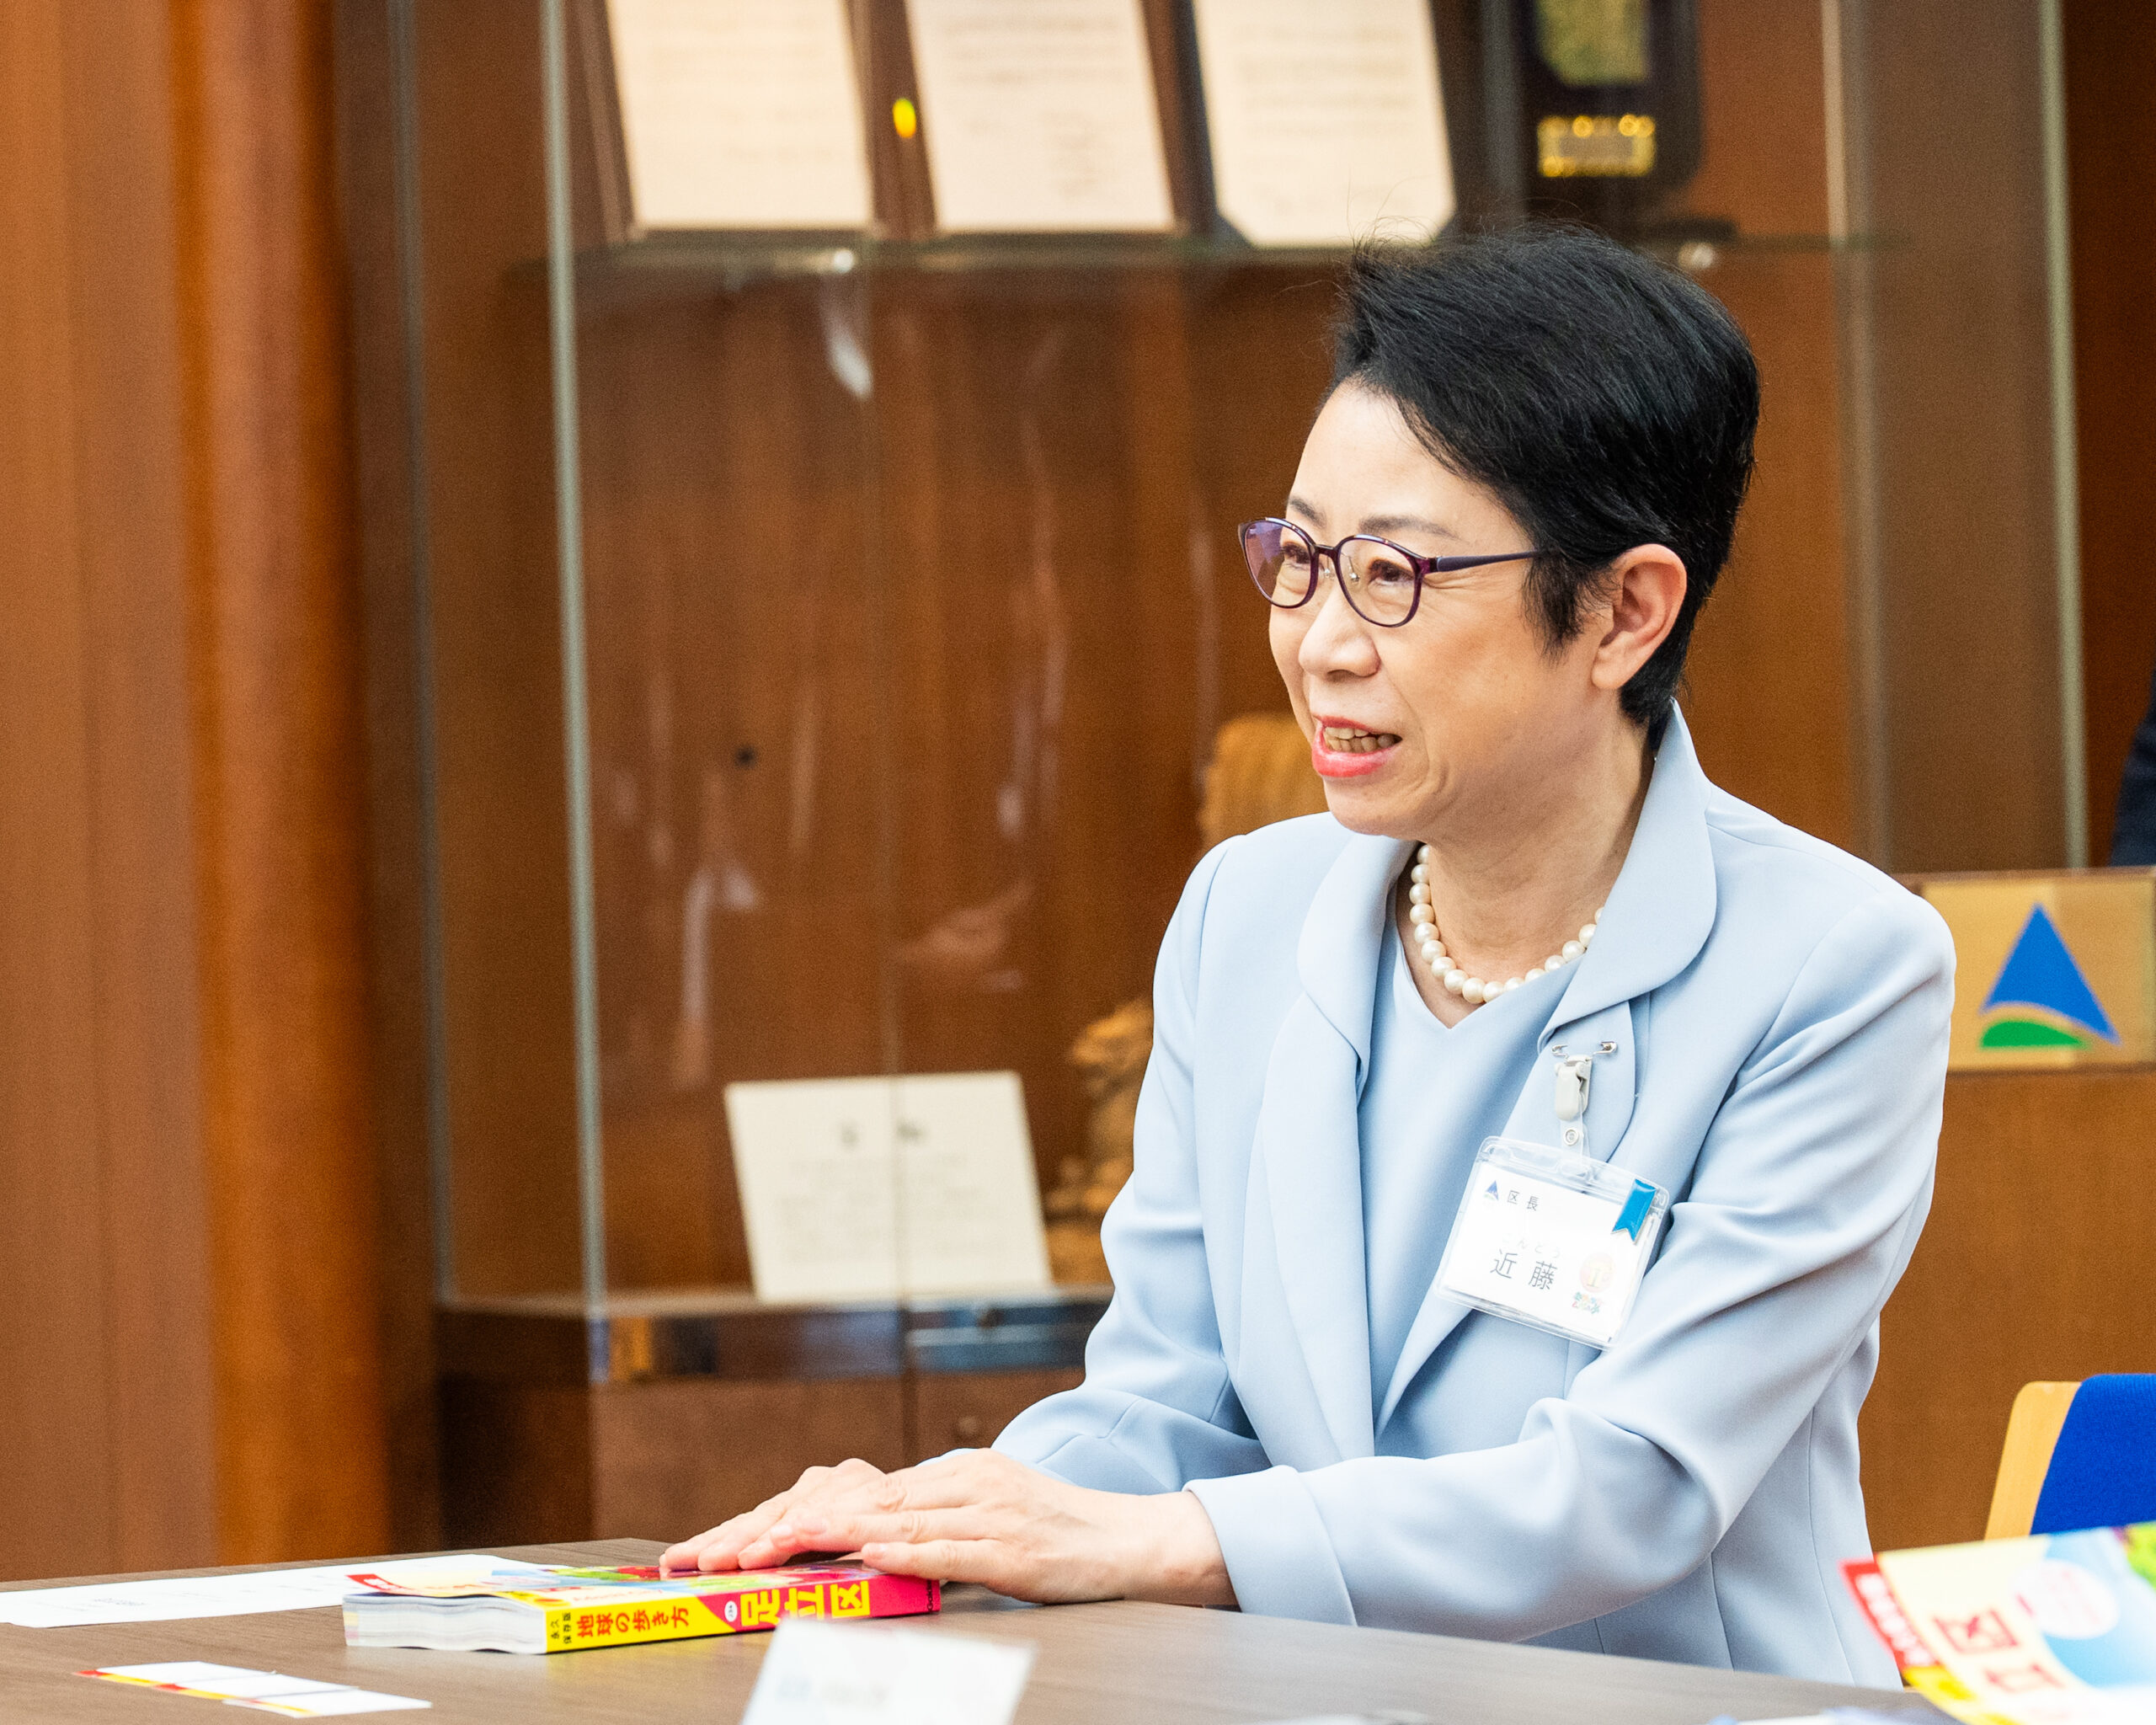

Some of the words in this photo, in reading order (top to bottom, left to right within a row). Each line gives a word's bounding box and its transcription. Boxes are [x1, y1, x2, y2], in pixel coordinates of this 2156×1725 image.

[1508, 1190, 1540, 1211] 区長
[1490, 1249, 1557, 1290] 近藤
[576, 1605, 690, 1638] 地球の歩き方
[739, 1580, 871, 1627] 足立区
